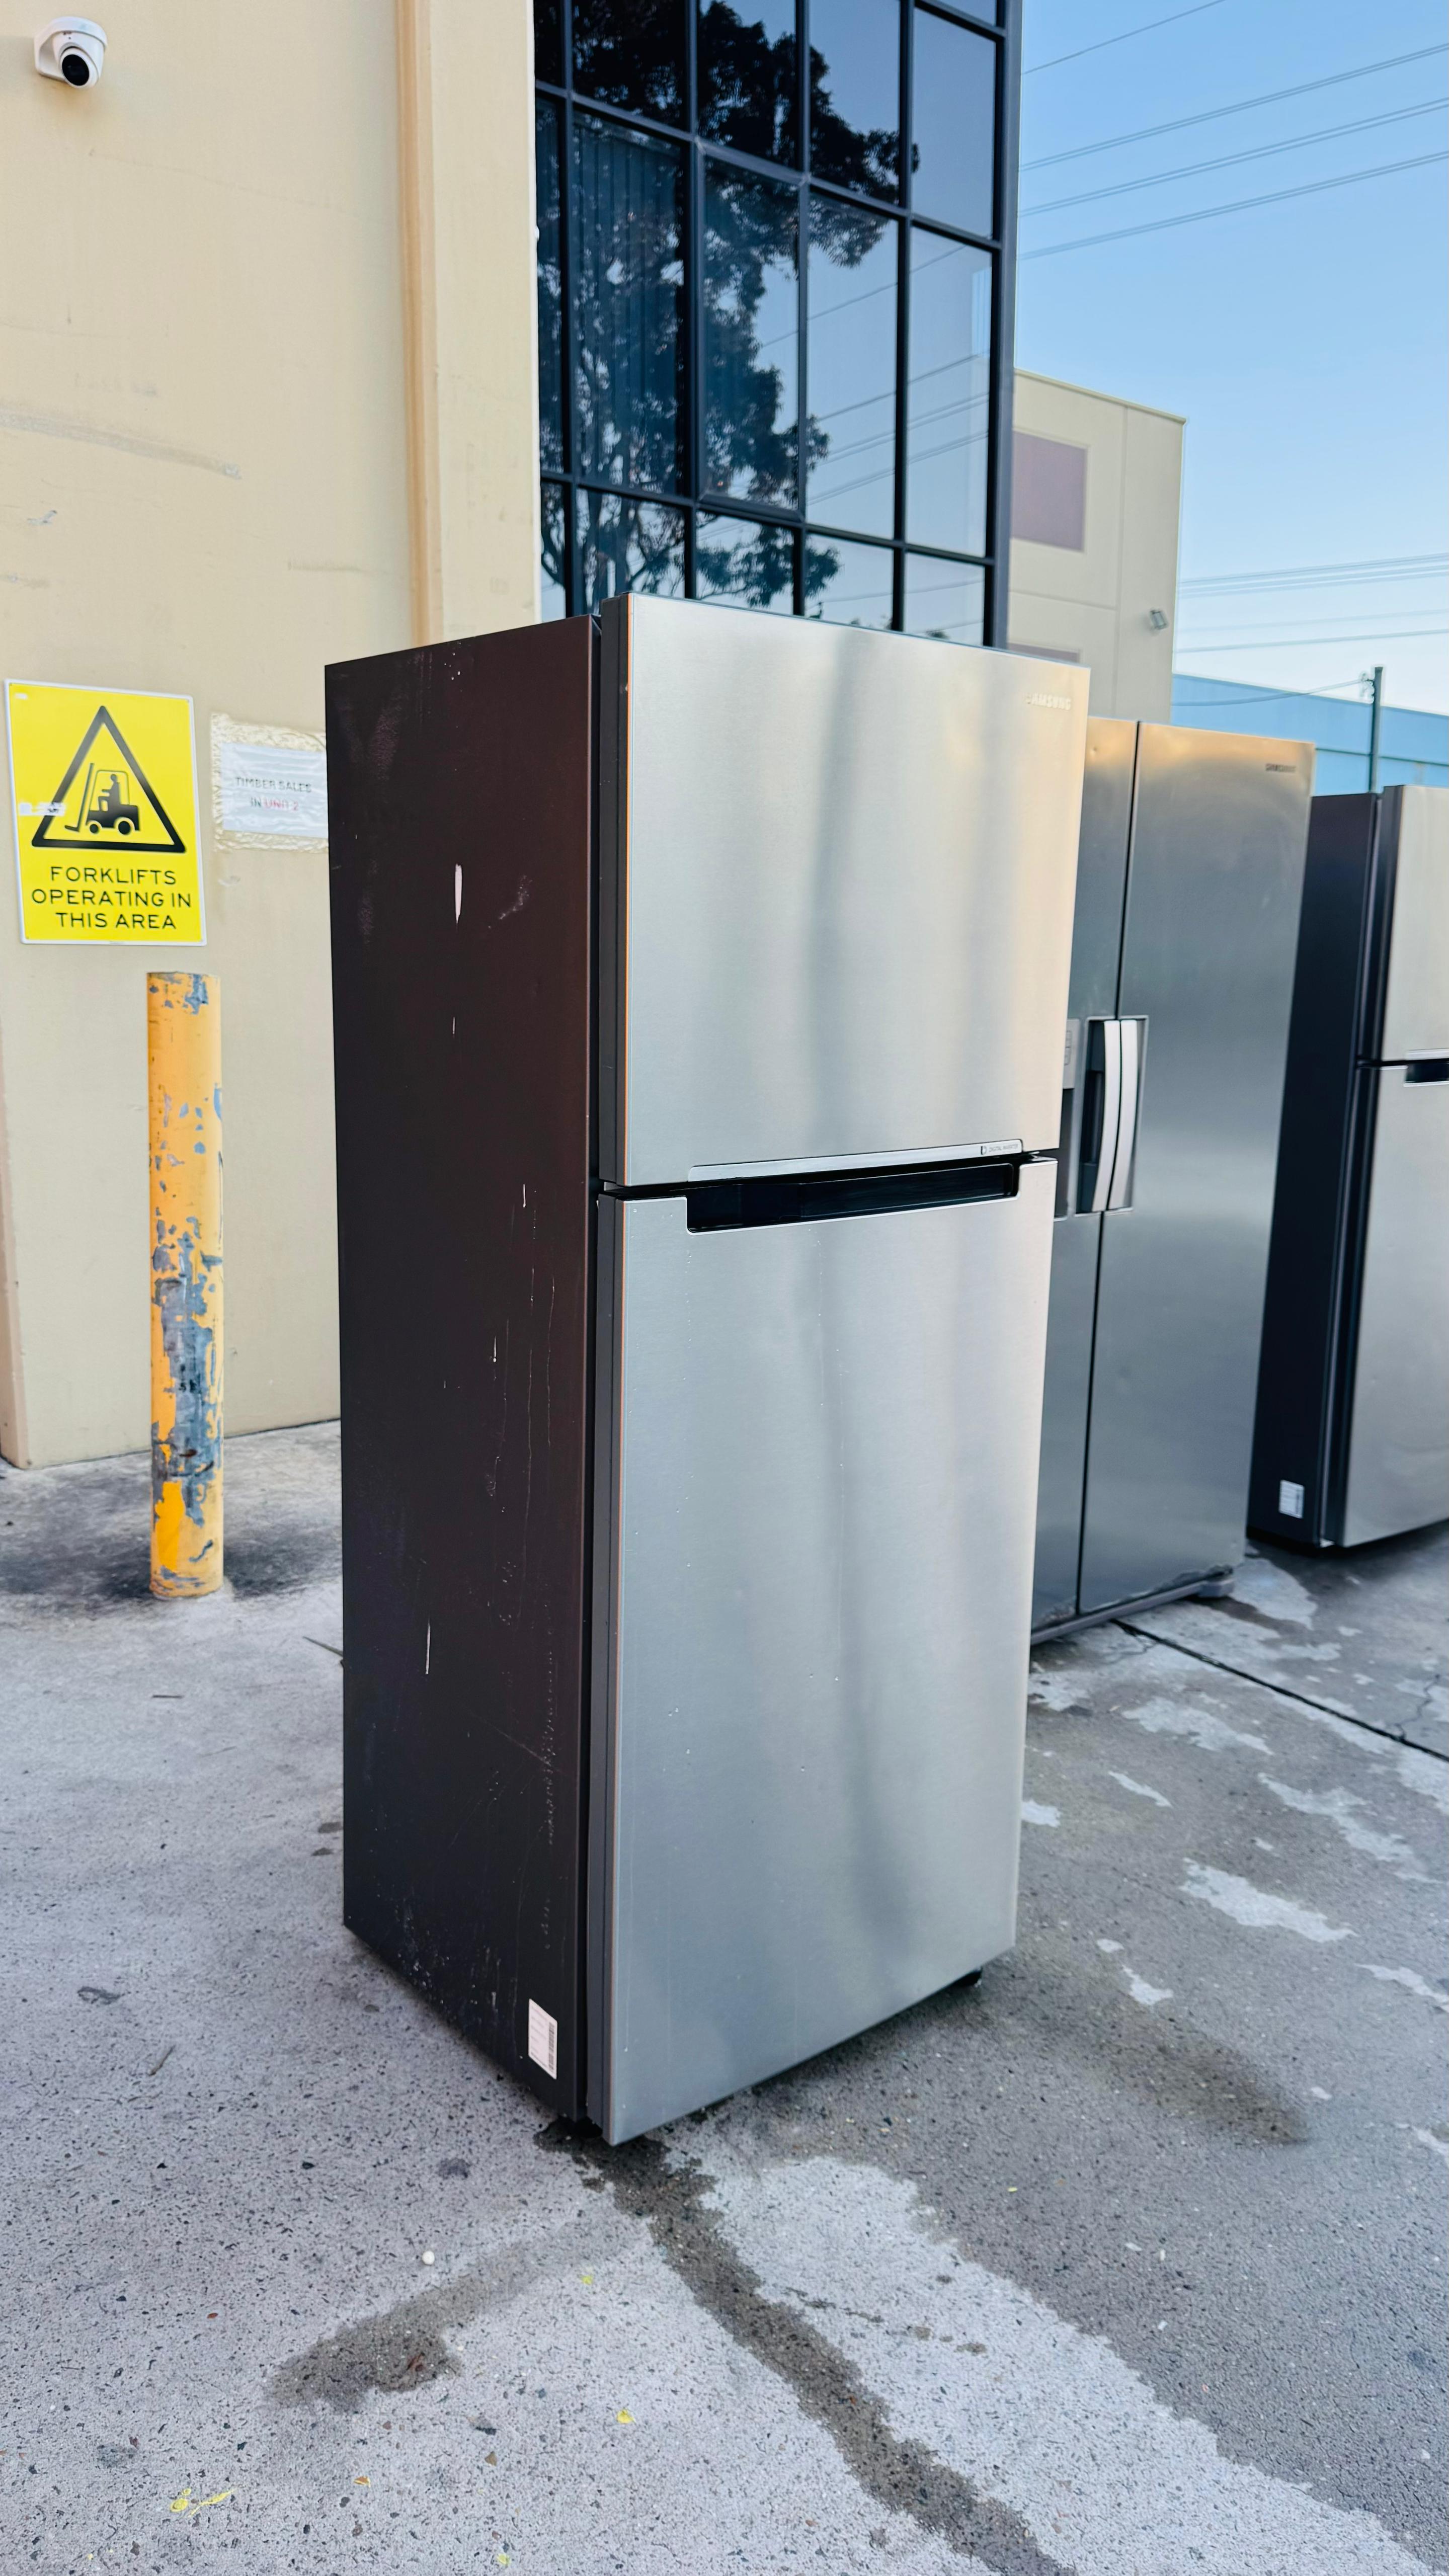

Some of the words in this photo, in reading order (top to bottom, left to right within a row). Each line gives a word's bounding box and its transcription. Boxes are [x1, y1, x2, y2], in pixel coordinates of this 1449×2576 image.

[235, 776, 276, 789] TIMBER
[278, 781, 311, 793] SALES
[293, 801, 298, 811] 2
[51, 866, 176, 886] FORKLIFTS
[32, 889, 164, 907] OPERATING
[172, 893, 191, 908] IN
[55, 912, 107, 928] THIS
[116, 914, 176, 929] AREA
